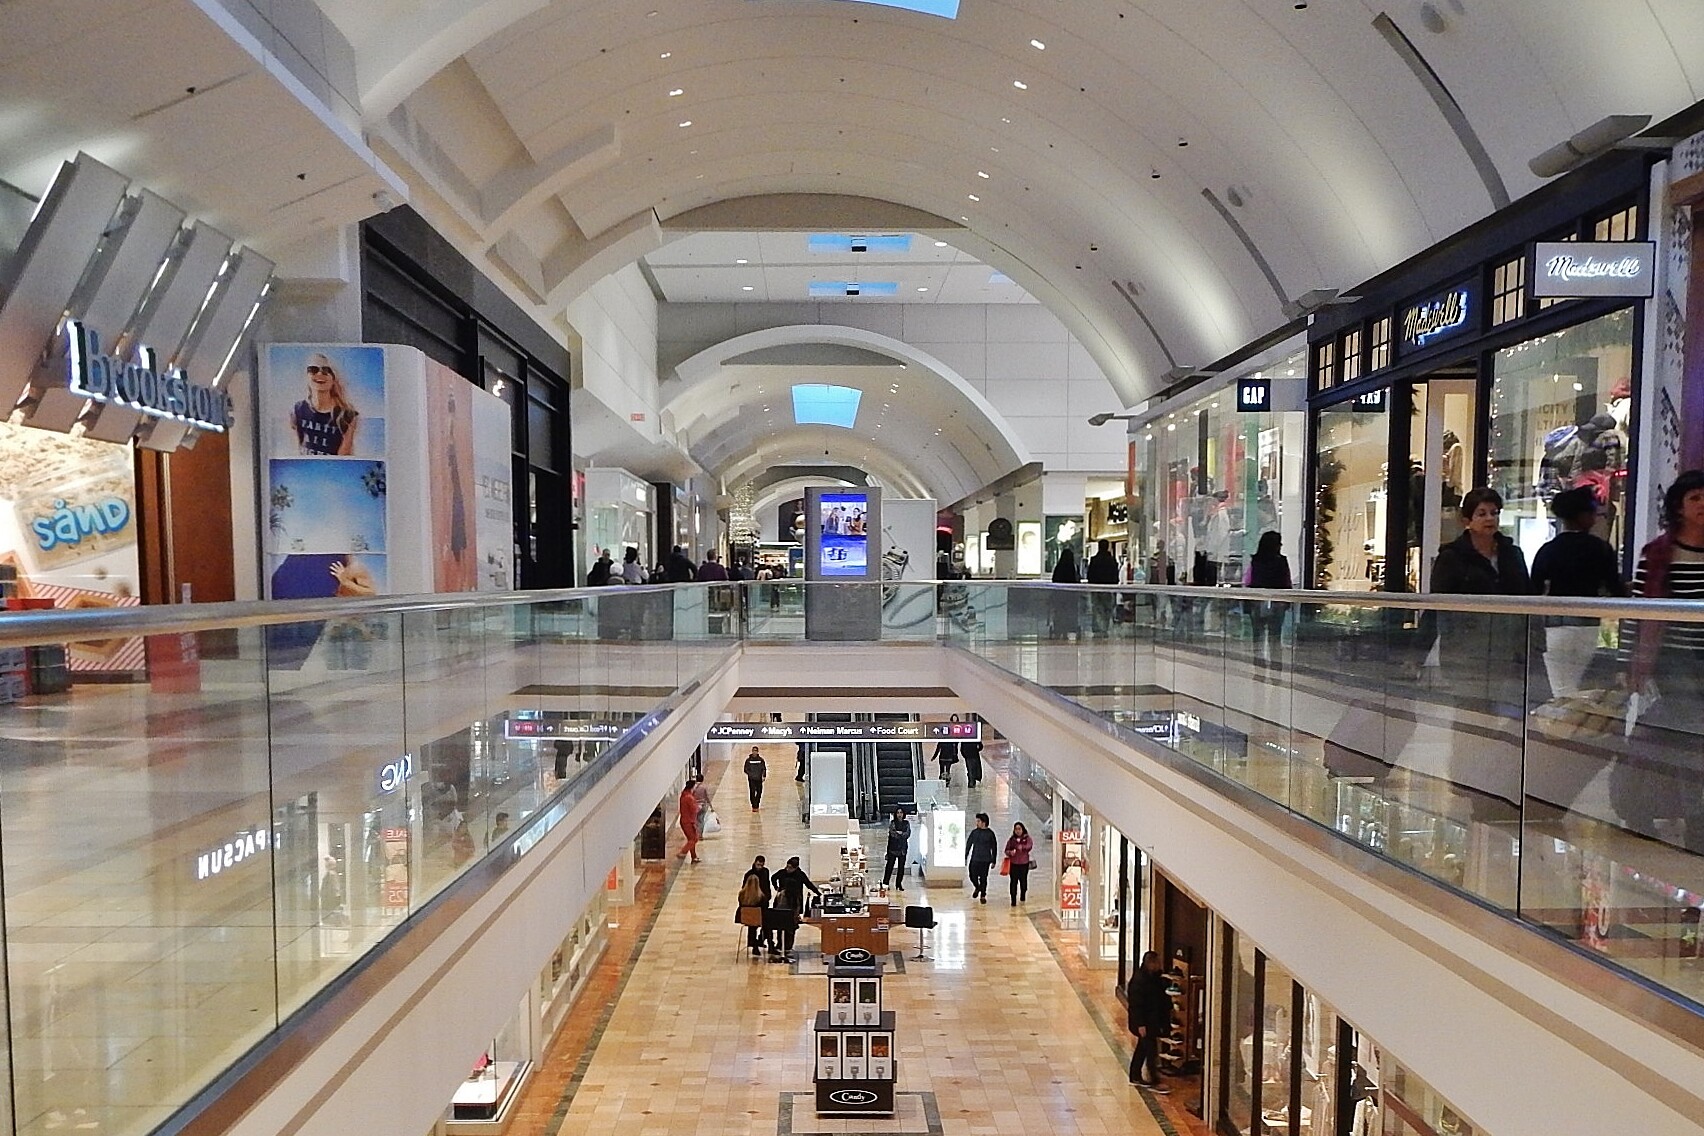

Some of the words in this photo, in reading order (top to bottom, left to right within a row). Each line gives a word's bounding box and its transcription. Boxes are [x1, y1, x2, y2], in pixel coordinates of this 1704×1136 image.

[1545, 255, 1641, 281] Madewell
[1242, 386, 1265, 405] GAP
[718, 726, 754, 736] JCPenney
[768, 726, 793, 736] Macy's
[807, 726, 834, 735] Neiman
[837, 726, 863, 735] Marcus
[877, 726, 896, 735] Food
[898, 726, 919, 735] Court
[841, 1092, 865, 1104] Candy
